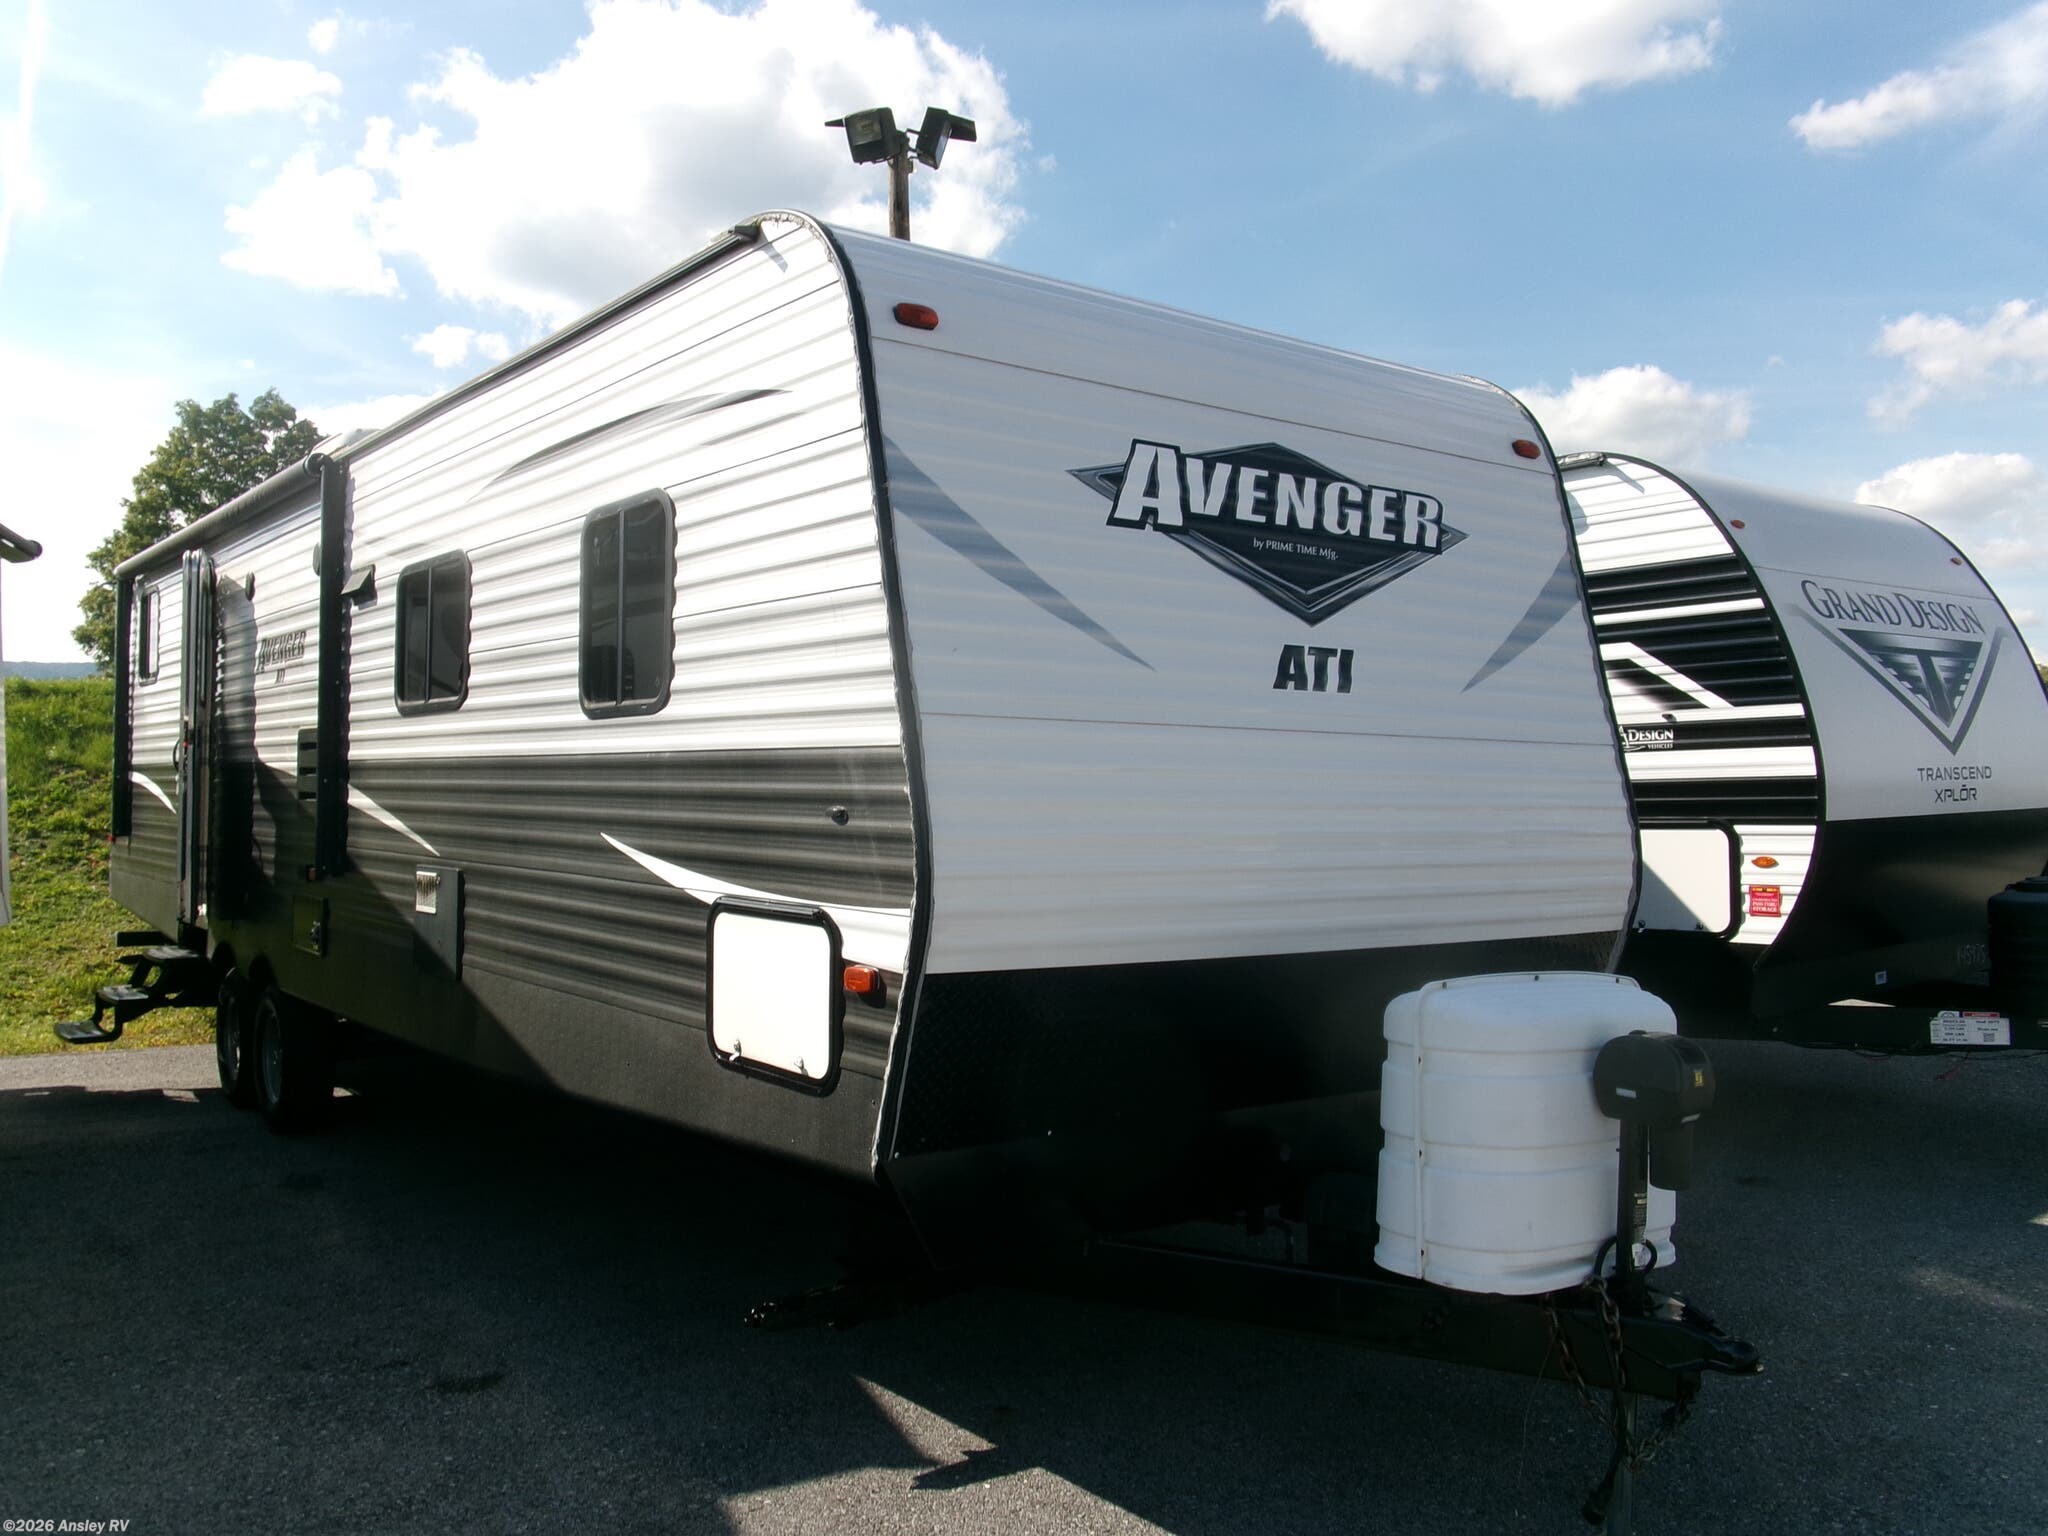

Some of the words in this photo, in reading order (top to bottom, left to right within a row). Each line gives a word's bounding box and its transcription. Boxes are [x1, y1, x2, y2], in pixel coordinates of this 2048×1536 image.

[1107, 439, 1442, 553] AVENGER
[1253, 537, 1264, 550] by
[1266, 540, 1294, 553] PRIME
[1296, 544, 1317, 556] TIME
[1319, 548, 1339, 561] Mfg.
[1801, 580, 1902, 626] GRAND
[1894, 593, 1985, 635] DESIGN
[1273, 644, 1355, 694] ATI
[1628, 729, 1674, 741] DESIGN
[1917, 766, 1992, 781] TRANSCEND
